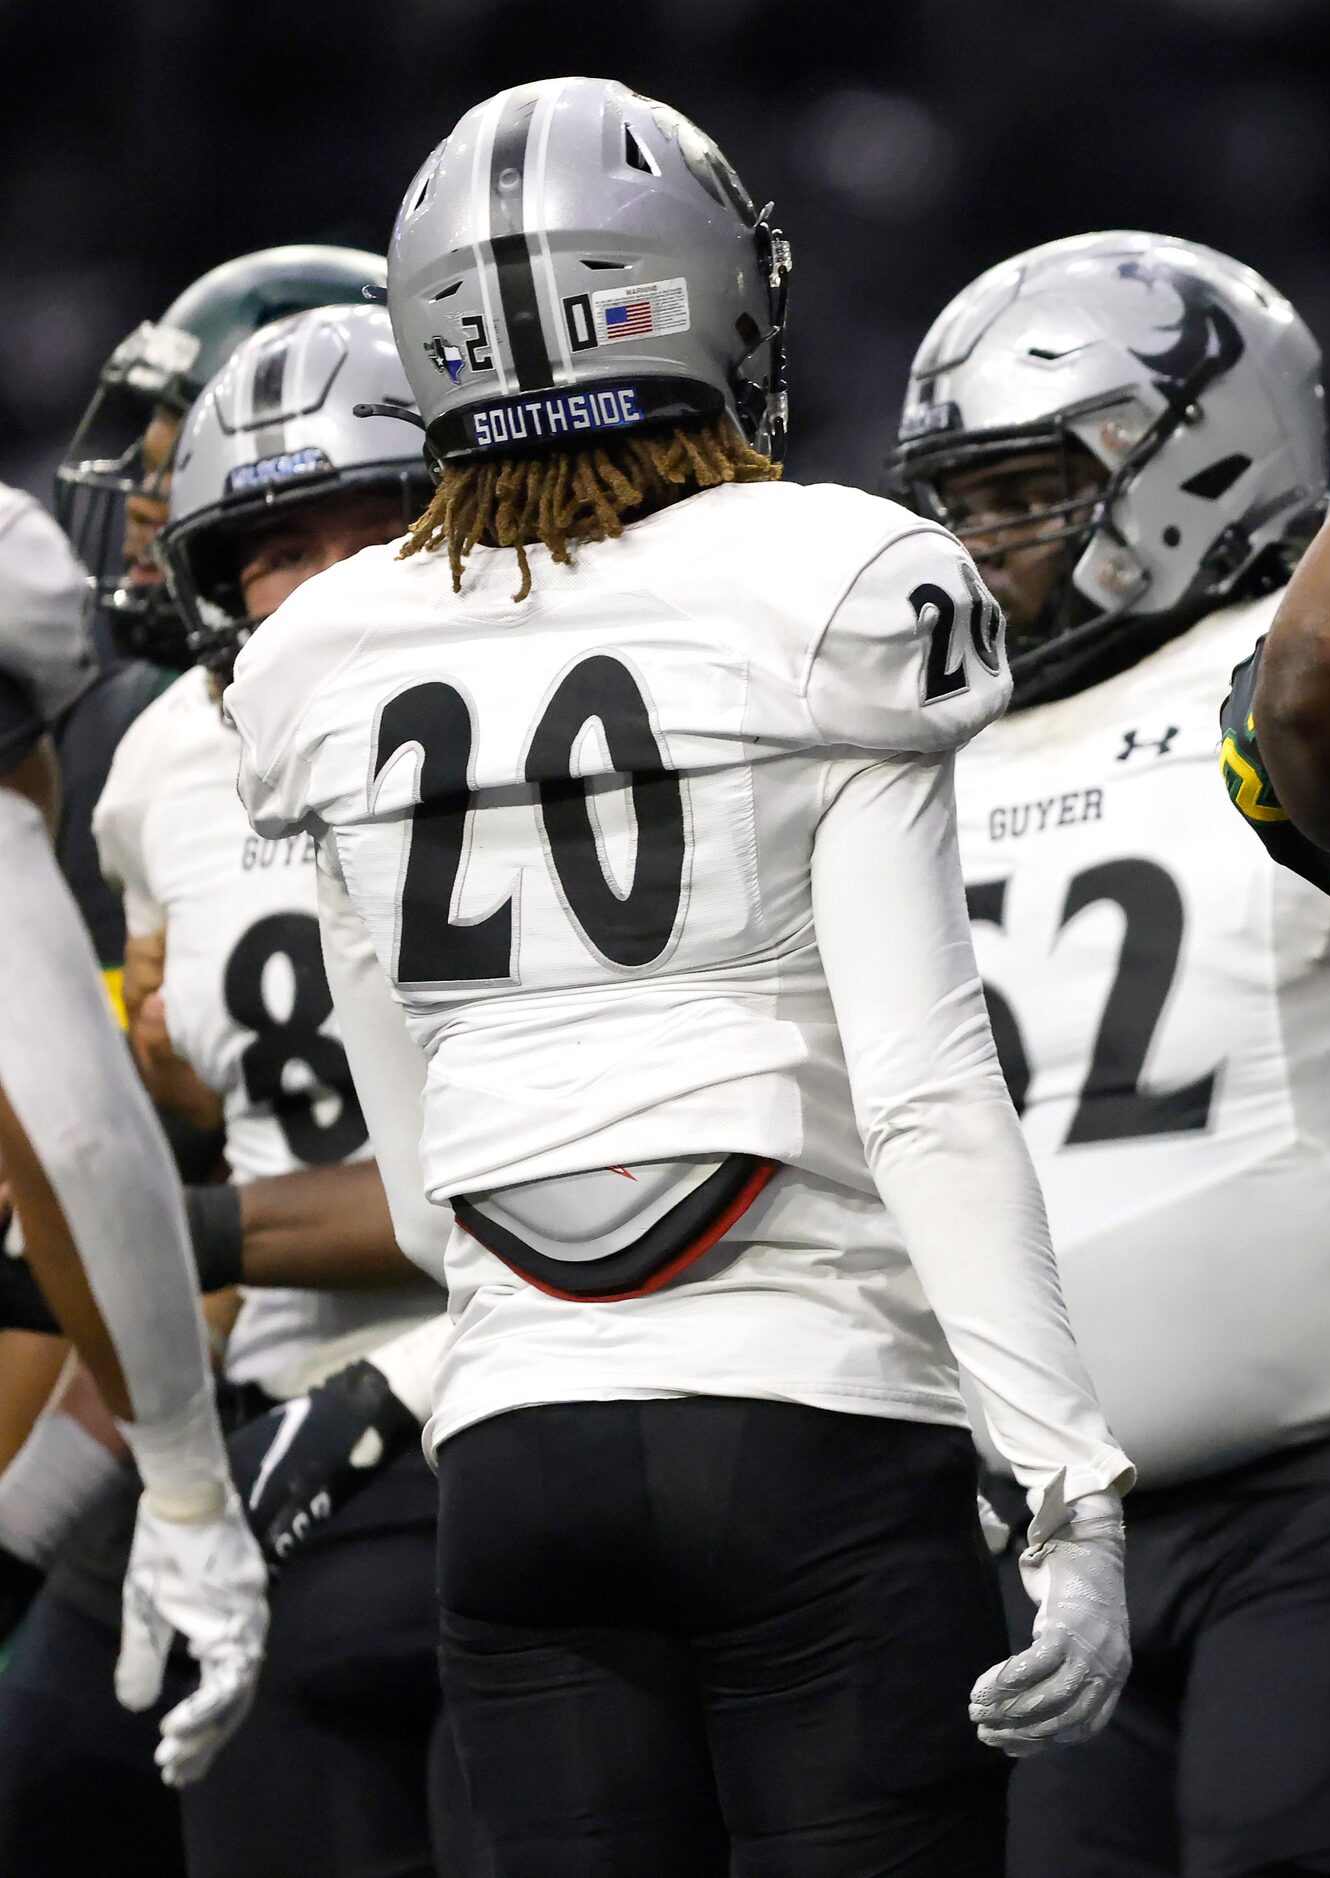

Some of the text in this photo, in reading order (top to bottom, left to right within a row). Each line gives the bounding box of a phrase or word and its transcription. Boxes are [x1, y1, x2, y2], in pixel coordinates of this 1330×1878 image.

[460, 313, 495, 374] 2
[562, 293, 599, 353] 0
[473, 389, 641, 446] SOUTHSIDE
[367, 647, 694, 990] 20
[988, 788, 1105, 841] GUYER
